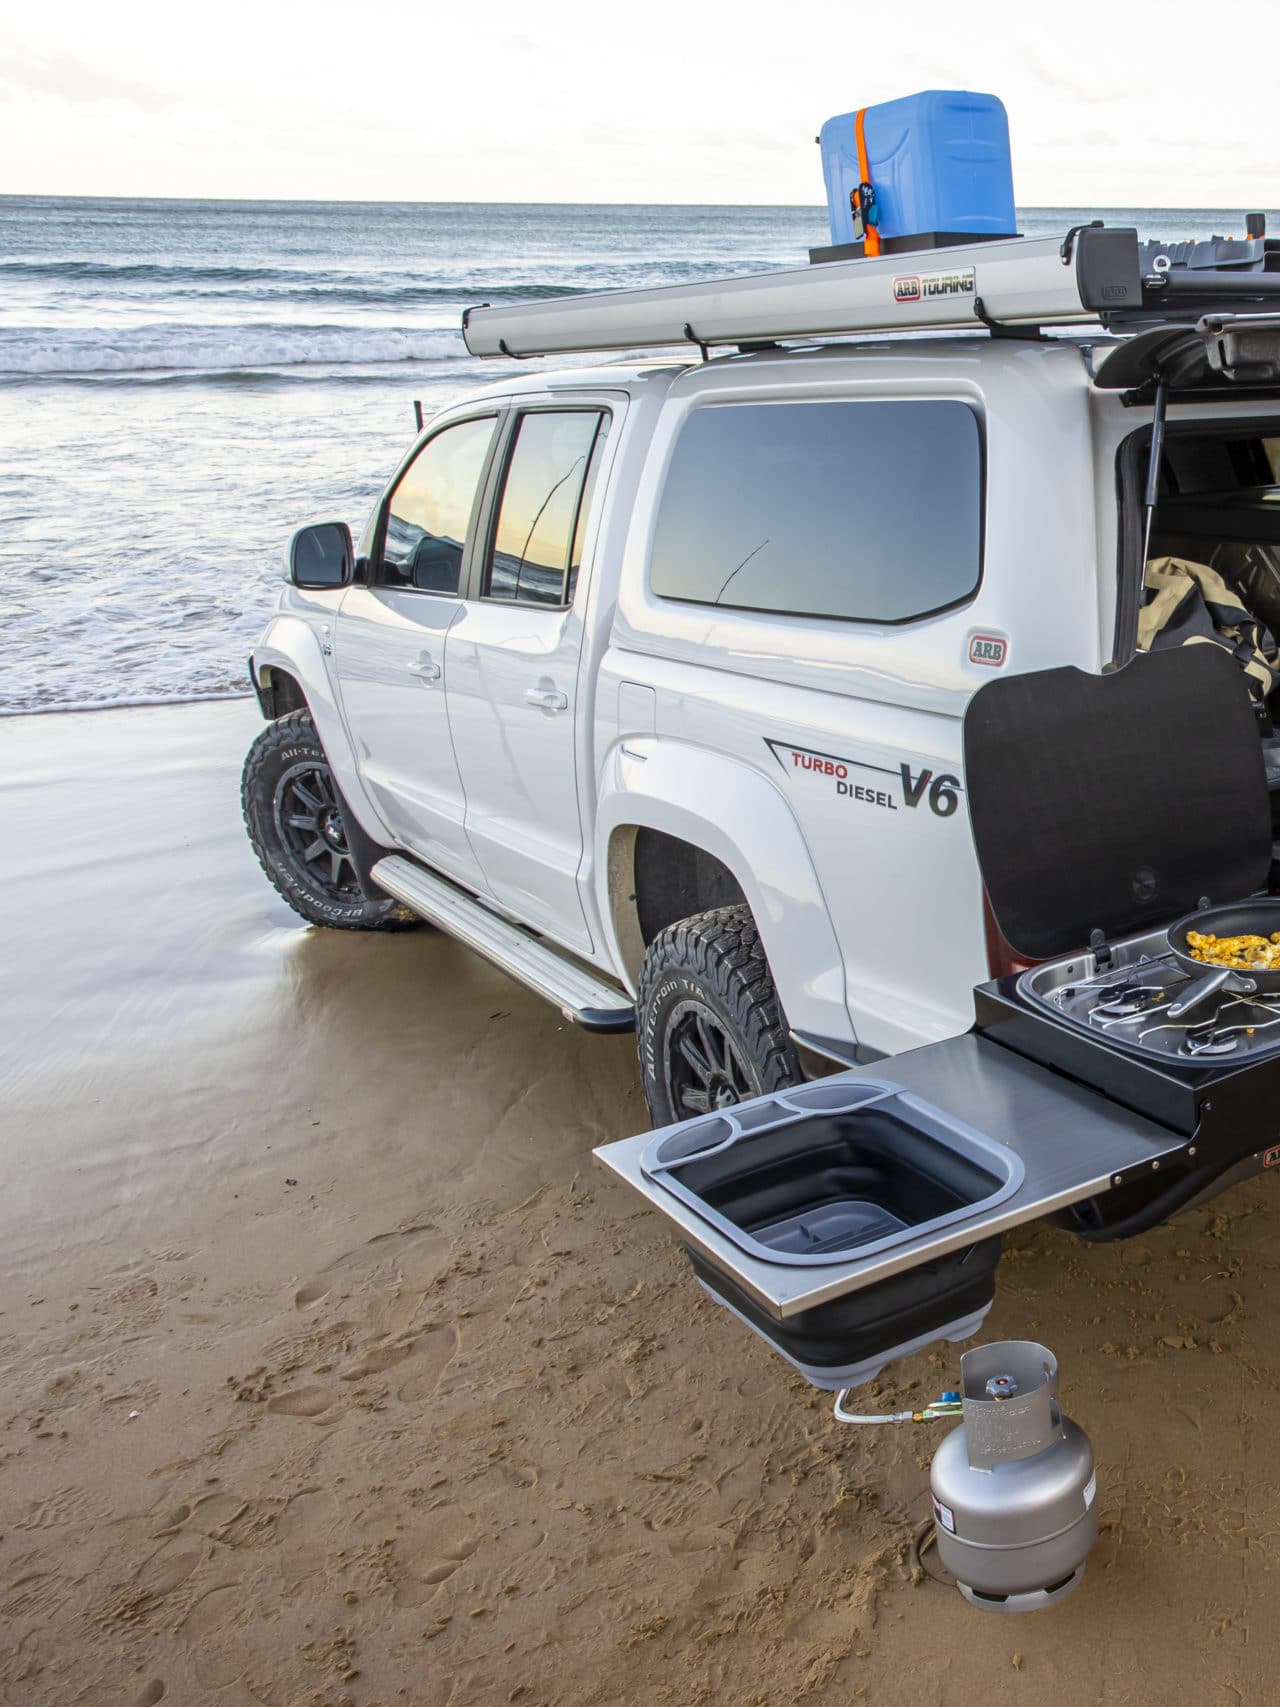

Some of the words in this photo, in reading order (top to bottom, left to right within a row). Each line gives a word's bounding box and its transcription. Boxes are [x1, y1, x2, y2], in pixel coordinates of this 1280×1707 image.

[897, 280, 918, 297] ARB
[922, 273, 974, 297] TOURING
[973, 641, 1002, 660] ARB
[791, 752, 848, 780] TURBO
[836, 781, 897, 810] DIESEL
[900, 763, 961, 817] V6
